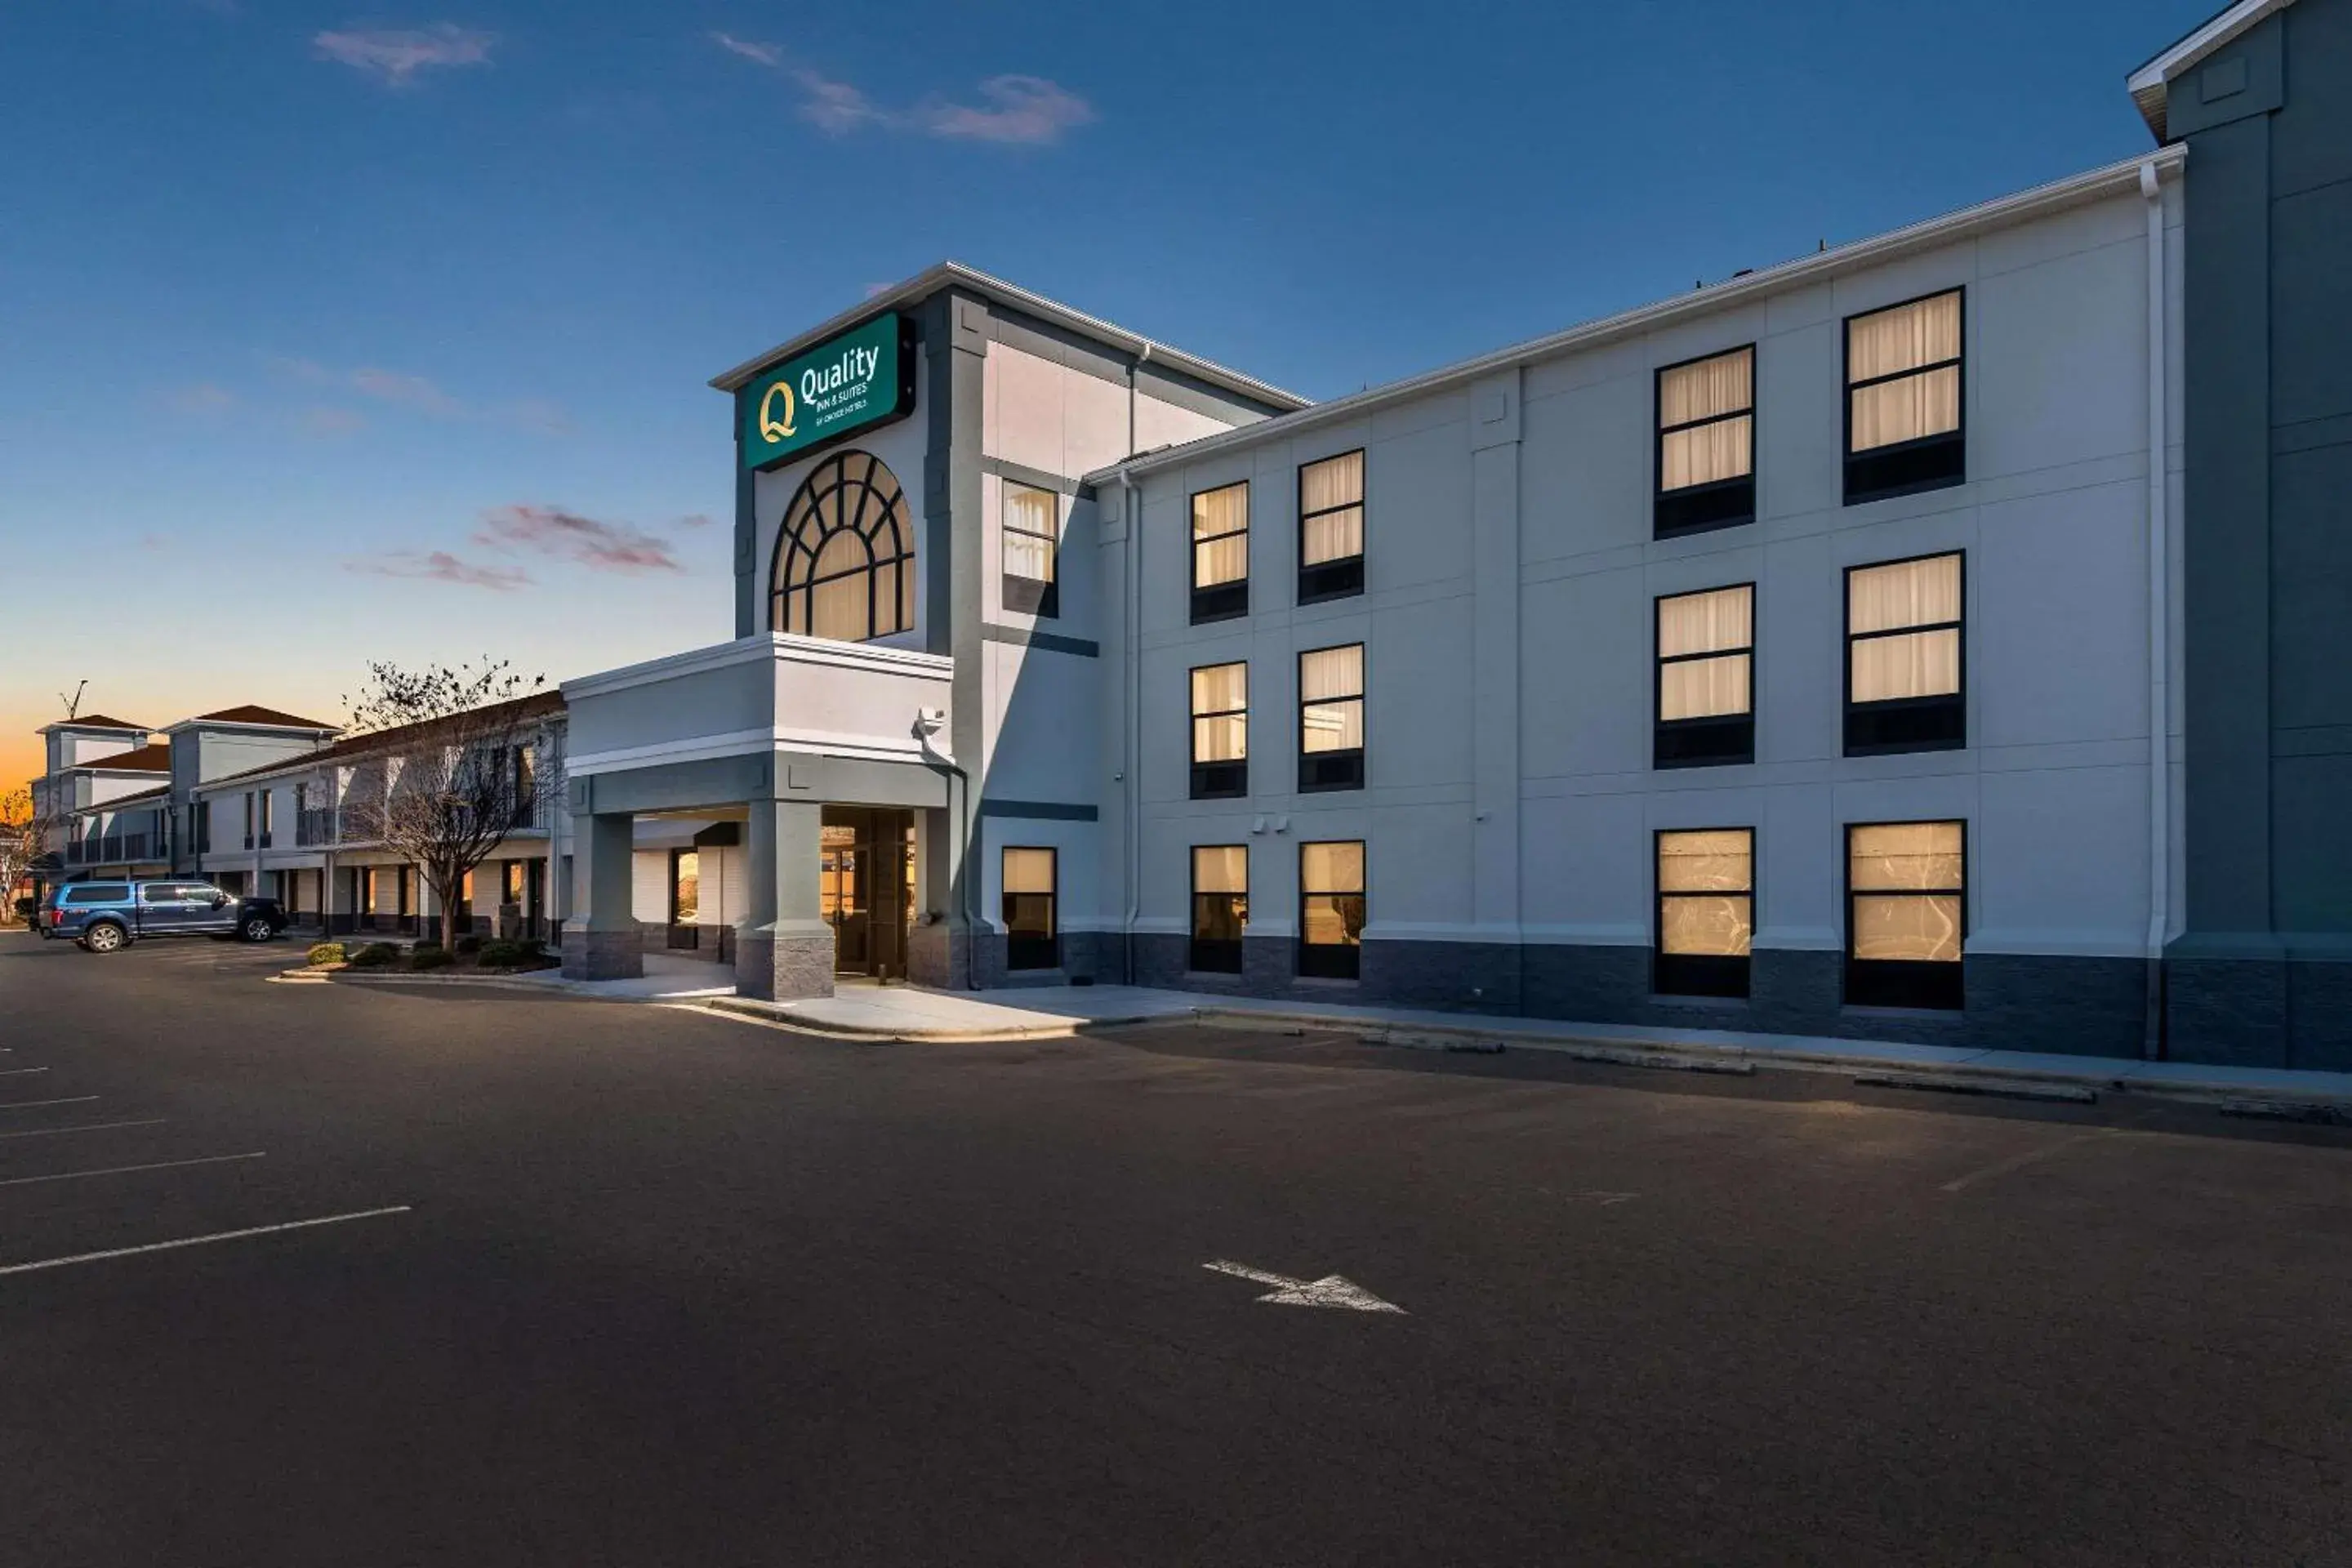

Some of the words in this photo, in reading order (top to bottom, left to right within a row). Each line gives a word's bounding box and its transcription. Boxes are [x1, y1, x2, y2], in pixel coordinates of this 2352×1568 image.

[801, 346, 879, 405] Quality
[817, 399, 830, 412] INN
[831, 394, 836, 406] &
[839, 382, 867, 403] SUITES
[760, 381, 797, 443] Q
